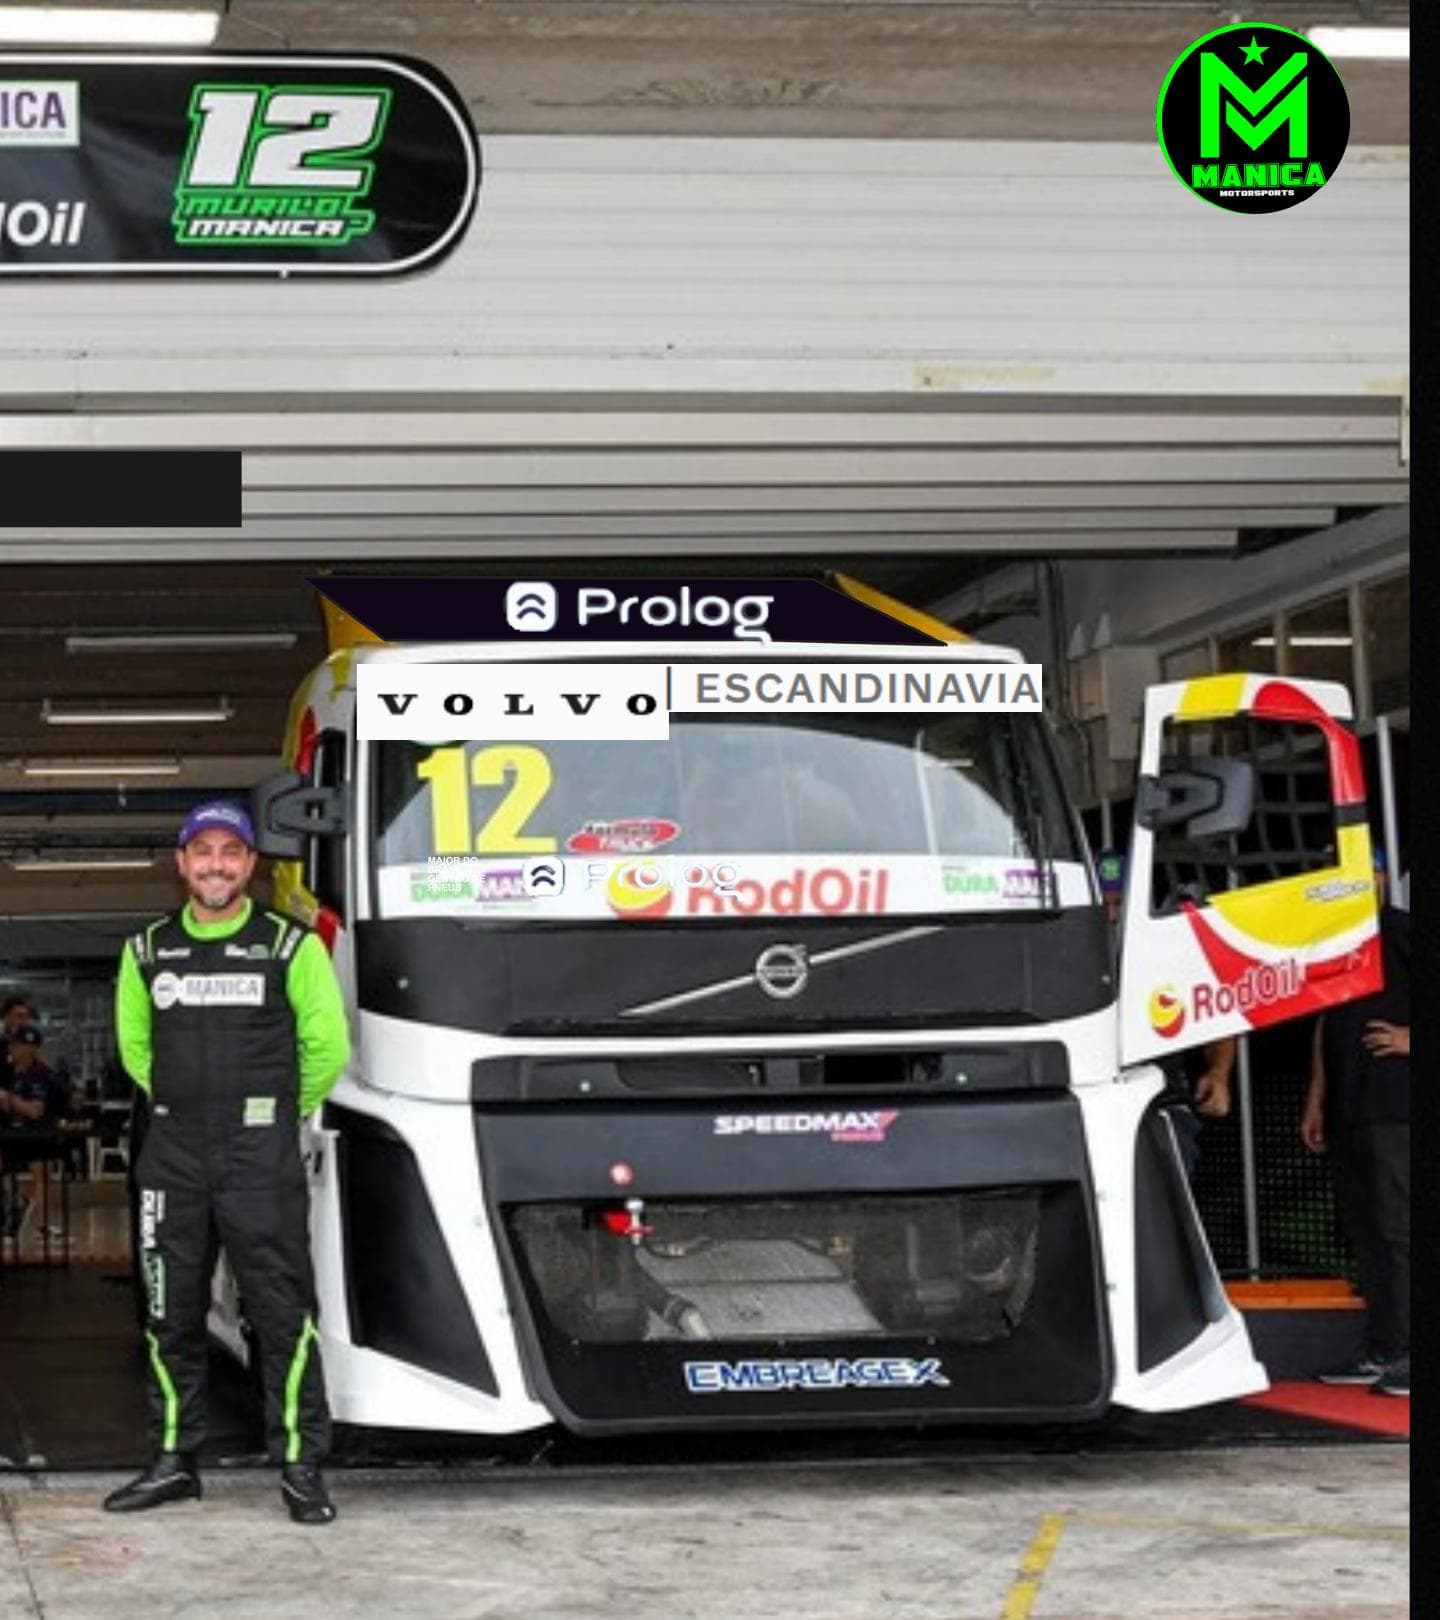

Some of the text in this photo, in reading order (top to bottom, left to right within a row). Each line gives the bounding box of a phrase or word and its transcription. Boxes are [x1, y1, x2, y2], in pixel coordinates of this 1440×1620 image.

[188, 91, 381, 187] 12
[187, 218, 346, 237] MANICA
[417, 744, 558, 854] 12
[1192, 957, 1299, 1022] RodOil
[713, 1111, 881, 1135] SPEEDMAX
